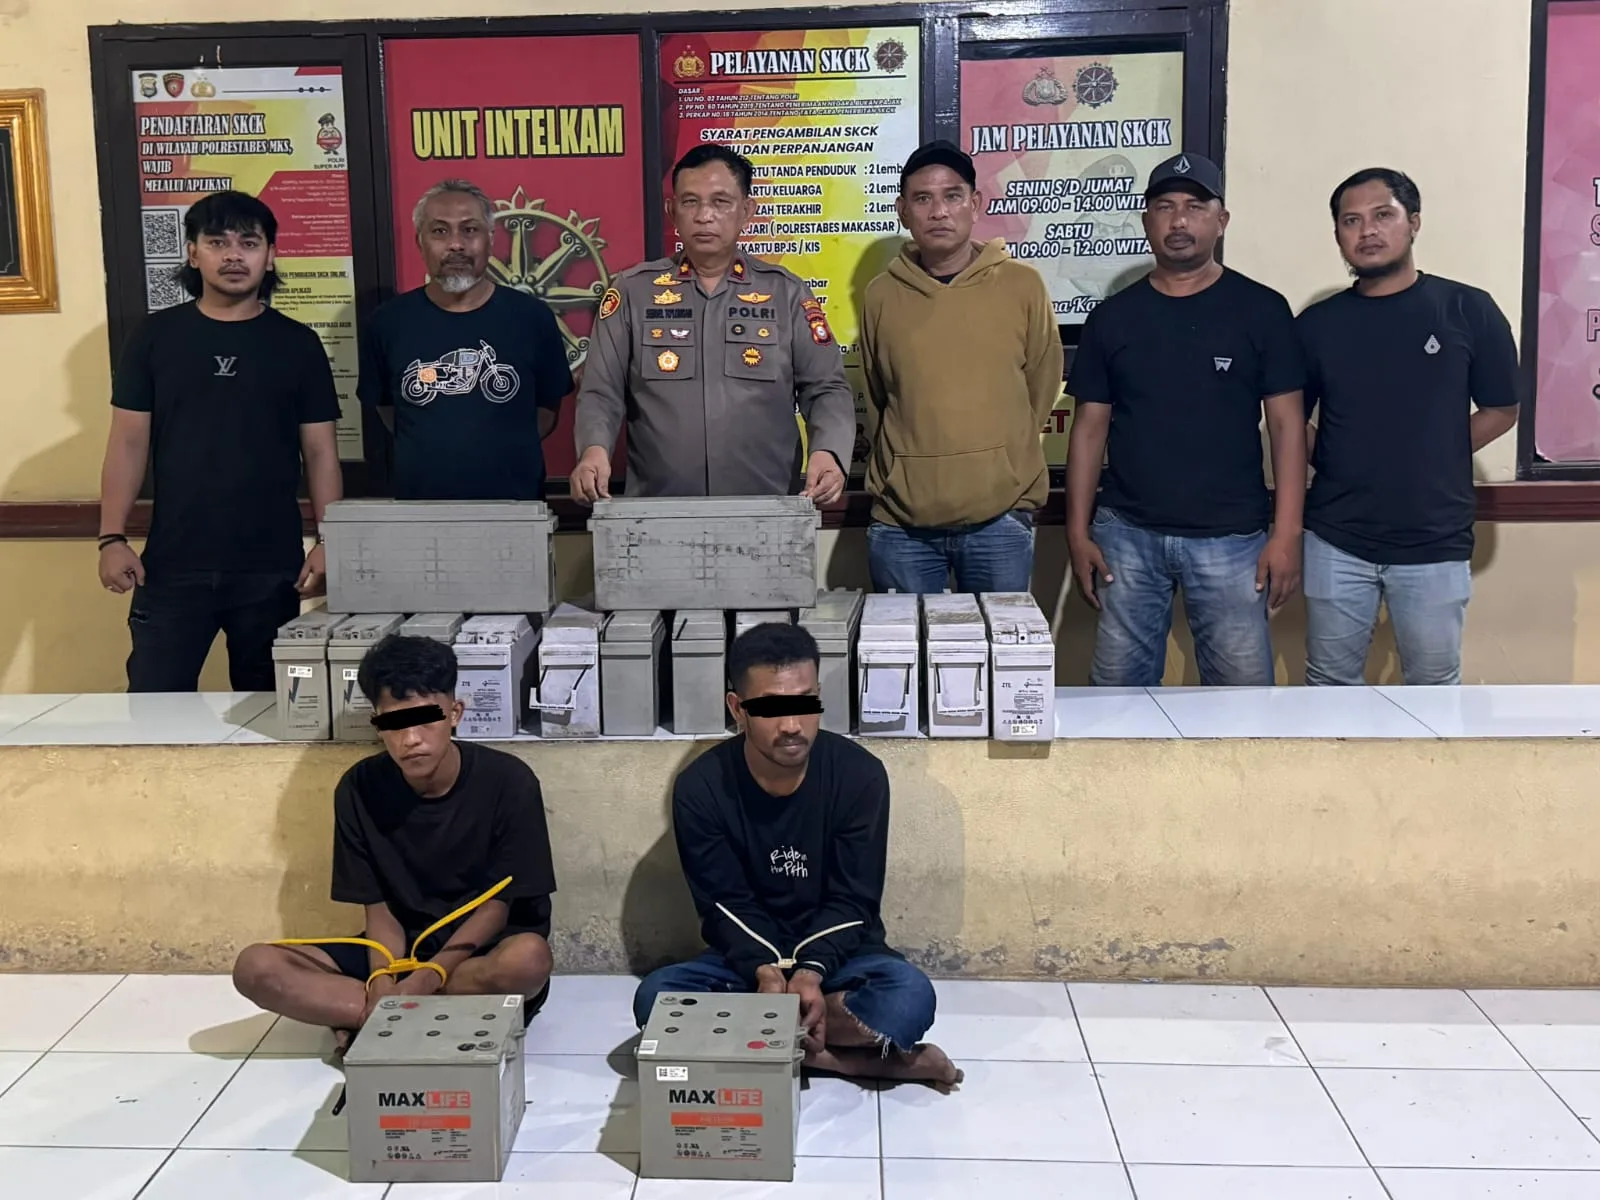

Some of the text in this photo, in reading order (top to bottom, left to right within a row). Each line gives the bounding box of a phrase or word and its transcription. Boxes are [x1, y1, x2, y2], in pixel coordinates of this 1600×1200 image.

[710, 48, 870, 75] PELAYANAN SKCK
[140, 114, 265, 136] PENDAFTARAN SKCK
[412, 107, 624, 158] UNIT INTELKAM
[702, 126, 878, 140] SYARAT PENGAMBILAN SKCK
[970, 119, 1171, 156] JAM PELAYANAN SKCK
[142, 140, 293, 155] DI WILAYAH POLRESTABES MKS,
[743, 144, 769, 154] DAN
[773, 142, 874, 154] PERPANJANGAN
[143, 160, 172, 174] WAJIB
[752, 165, 856, 177] RTU TANDA PENDUDUK
[876, 163, 904, 174] Lemb
[144, 178, 231, 192] MELALUI APLIKASI
[747, 185, 822, 196] ARTU KELUARGA
[1006, 178, 1133, 197] SENIN S/D JUMAT
[756, 204, 822, 216] ZAH TERAKHIR
[876, 203, 896, 213] Lem
[987, 200, 1017, 215] JAM
[1021, 198, 1059, 213] 09.00
[1074, 196, 1113, 212] 14.00
[748, 223, 768, 234] JARI
[776, 222, 840, 234] POLRESTABES
[841, 222, 895, 233] MAKASSAR
[1046, 224, 1093, 240] SABTU
[742, 243, 772, 254] KARTU
[774, 242, 797, 253] BPJS
[805, 242, 820, 252] KIS
[1021, 242, 1059, 258] 09.00
[1074, 241, 1113, 256] 12.00
[1116, 240, 1152, 256] WITA
[728, 307, 775, 319] POLRI
[770, 846, 801, 864] Ride
